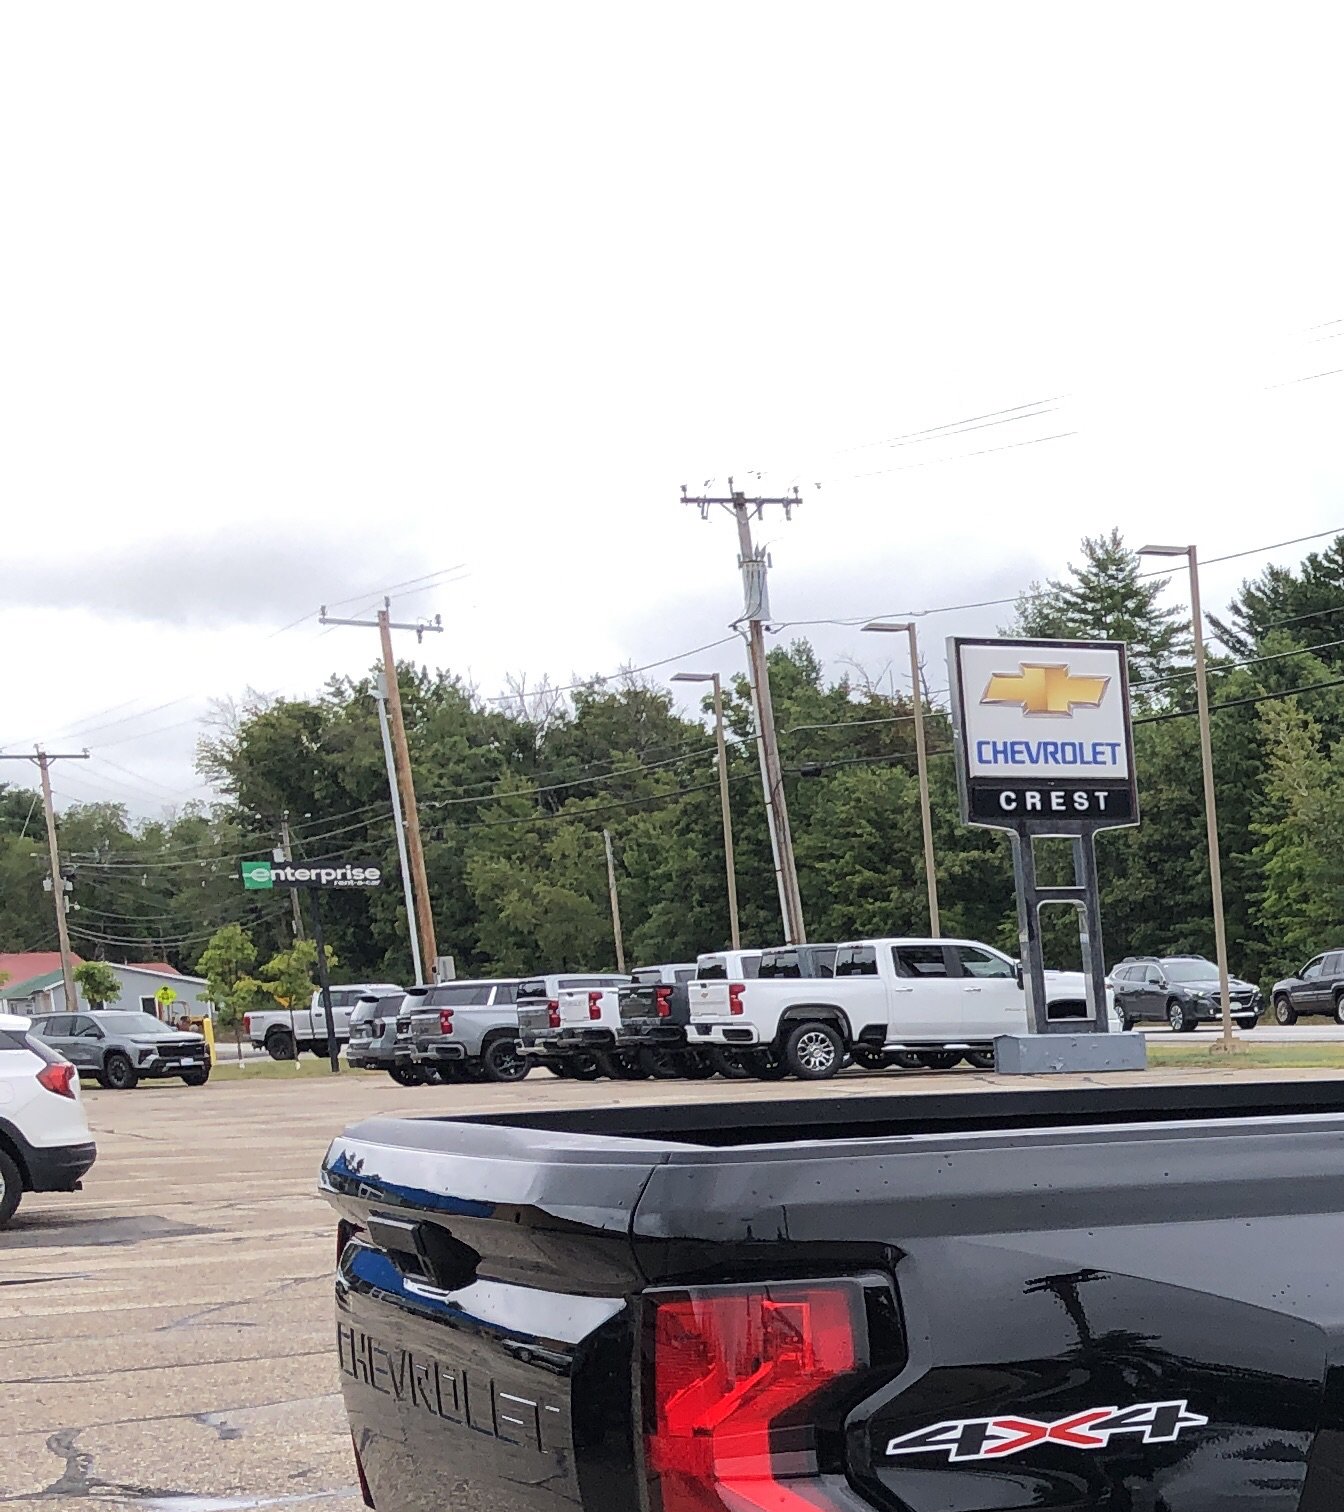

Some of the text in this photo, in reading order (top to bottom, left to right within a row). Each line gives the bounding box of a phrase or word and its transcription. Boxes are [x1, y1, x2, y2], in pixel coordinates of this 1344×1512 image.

[976, 740, 1121, 766] CHEVROLET
[999, 790, 1109, 811] CREST
[250, 864, 381, 884] enterprise
[333, 879, 381, 887] rent-a-car
[336, 1321, 560, 1454] CHEVROLET
[885, 1399, 1209, 1463] 4X4
